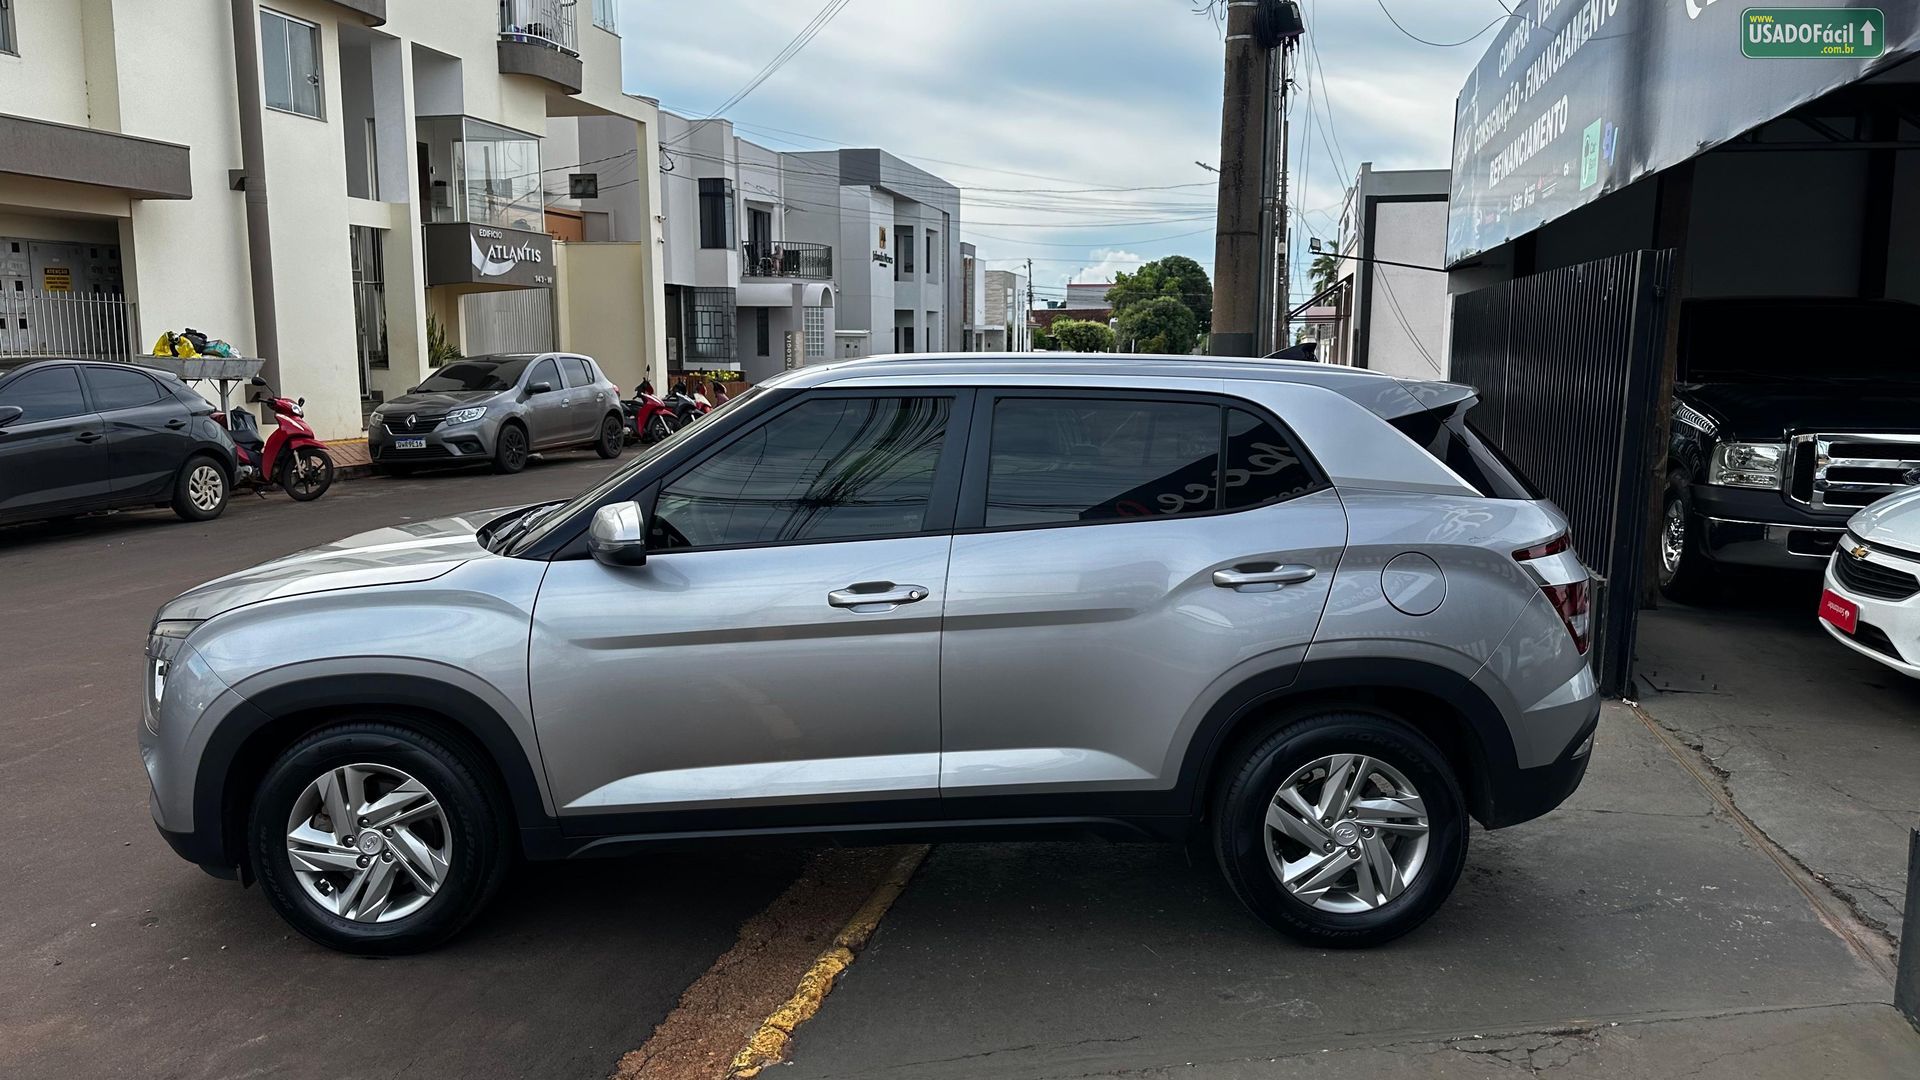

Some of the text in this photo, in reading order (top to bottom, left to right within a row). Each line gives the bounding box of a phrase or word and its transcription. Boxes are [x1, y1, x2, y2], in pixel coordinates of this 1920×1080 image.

[1498, 11, 1530, 78] COMPRA
[1488, 94, 1568, 190] REFINANCIAMENTO
[481, 239, 541, 273] ATLANTIS
